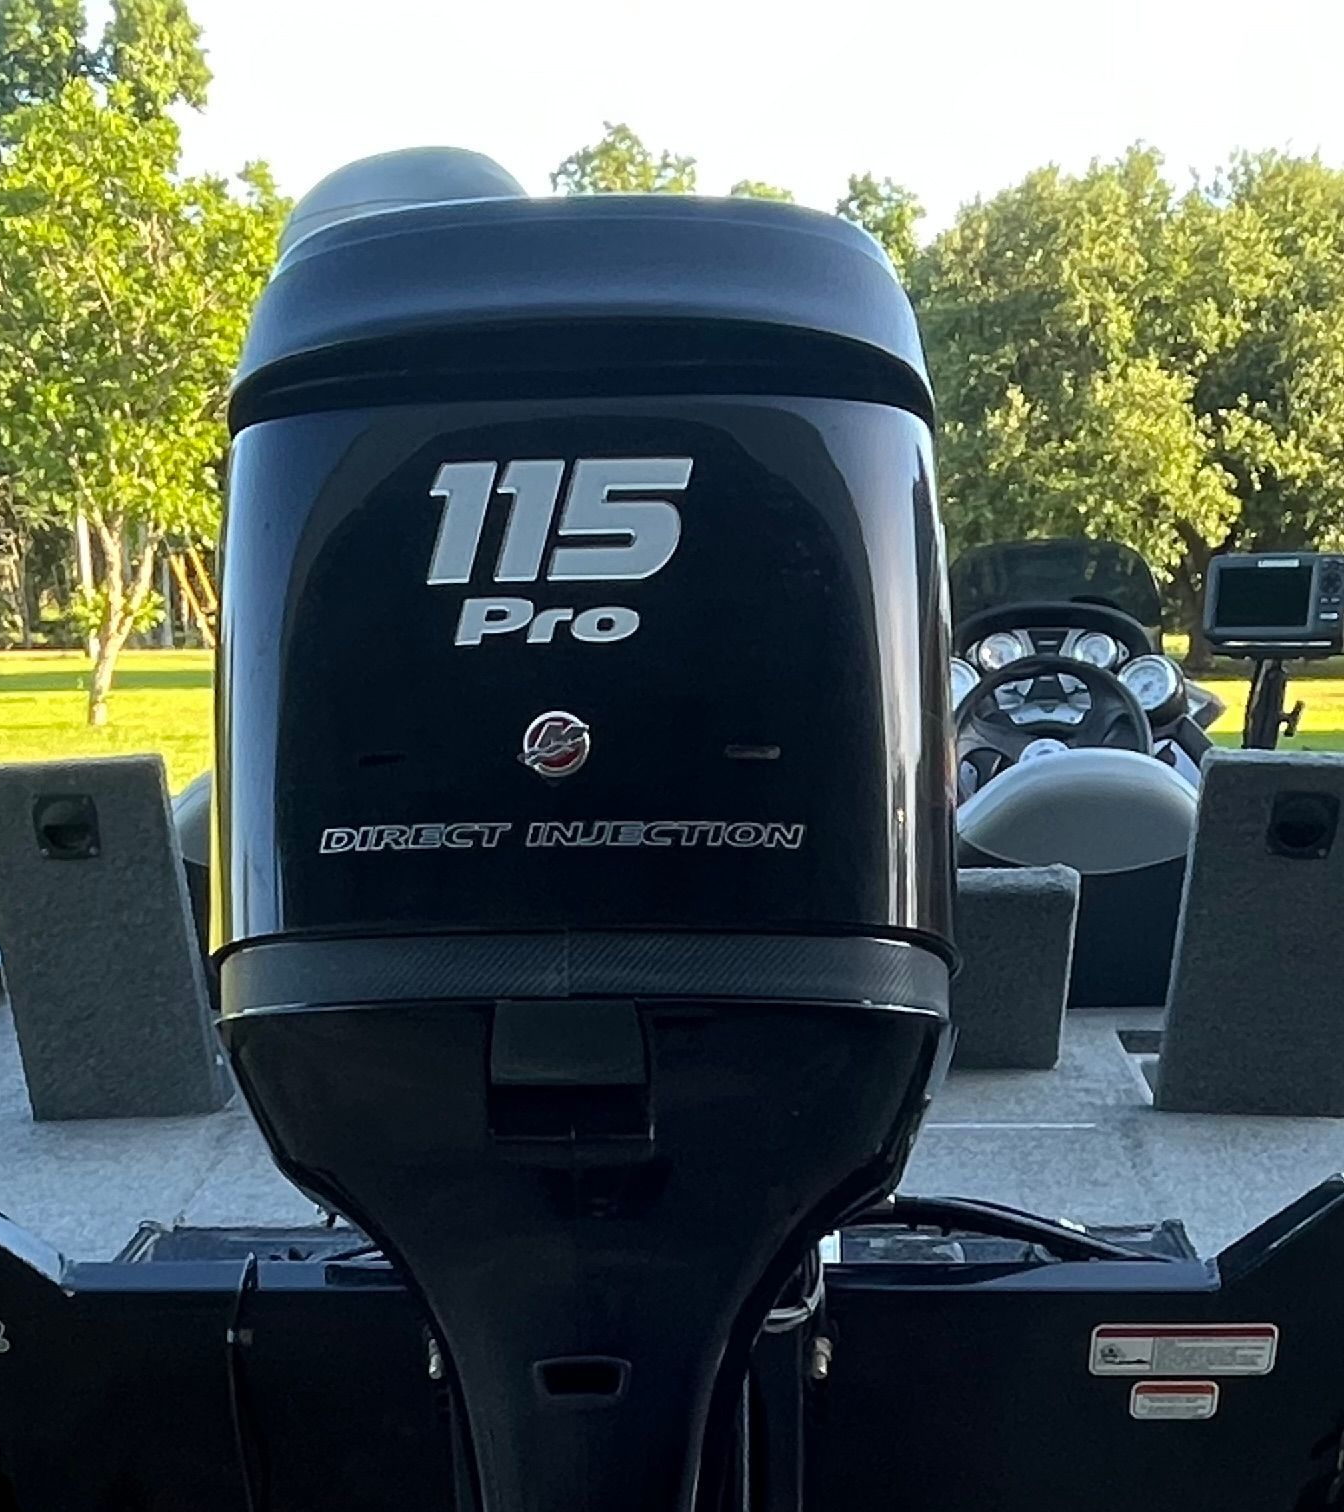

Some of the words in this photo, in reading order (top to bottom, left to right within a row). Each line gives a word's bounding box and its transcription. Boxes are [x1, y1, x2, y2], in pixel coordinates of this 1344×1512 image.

[426, 457, 694, 586] 115
[454, 597, 640, 646] Pro
[318, 822, 512, 854] DIRECT
[525, 820, 806, 850] INJECTION
